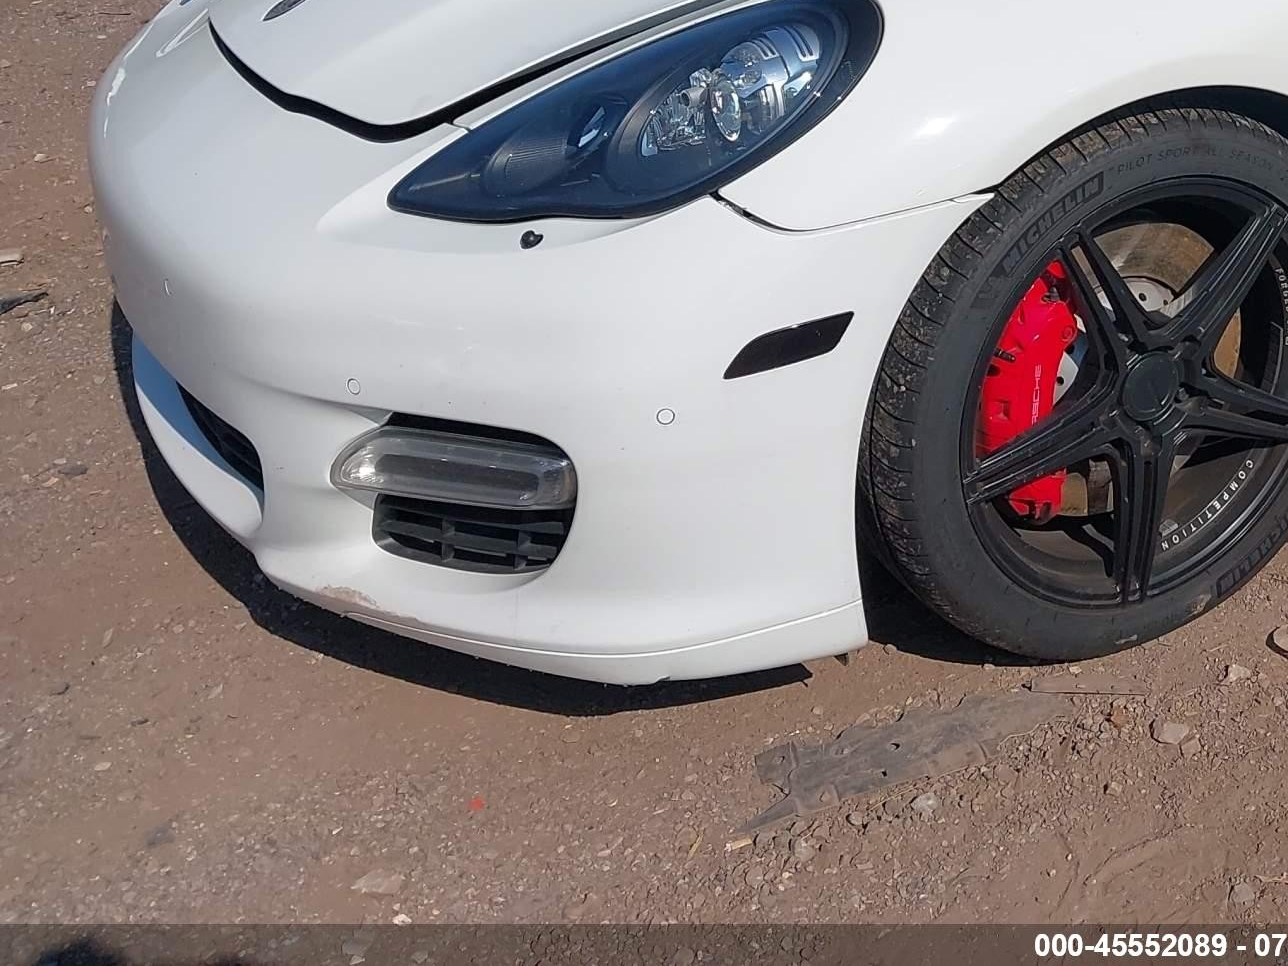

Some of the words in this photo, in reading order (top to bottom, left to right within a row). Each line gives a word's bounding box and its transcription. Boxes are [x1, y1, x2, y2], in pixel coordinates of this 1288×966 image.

[1116, 153, 1153, 175] PILOT
[1156, 145, 1199, 162] SPORT
[1001, 174, 1101, 276] MICHELIN
[1031, 364, 1042, 427] RSCHE
[1161, 459, 1254, 552] COMPETITION
